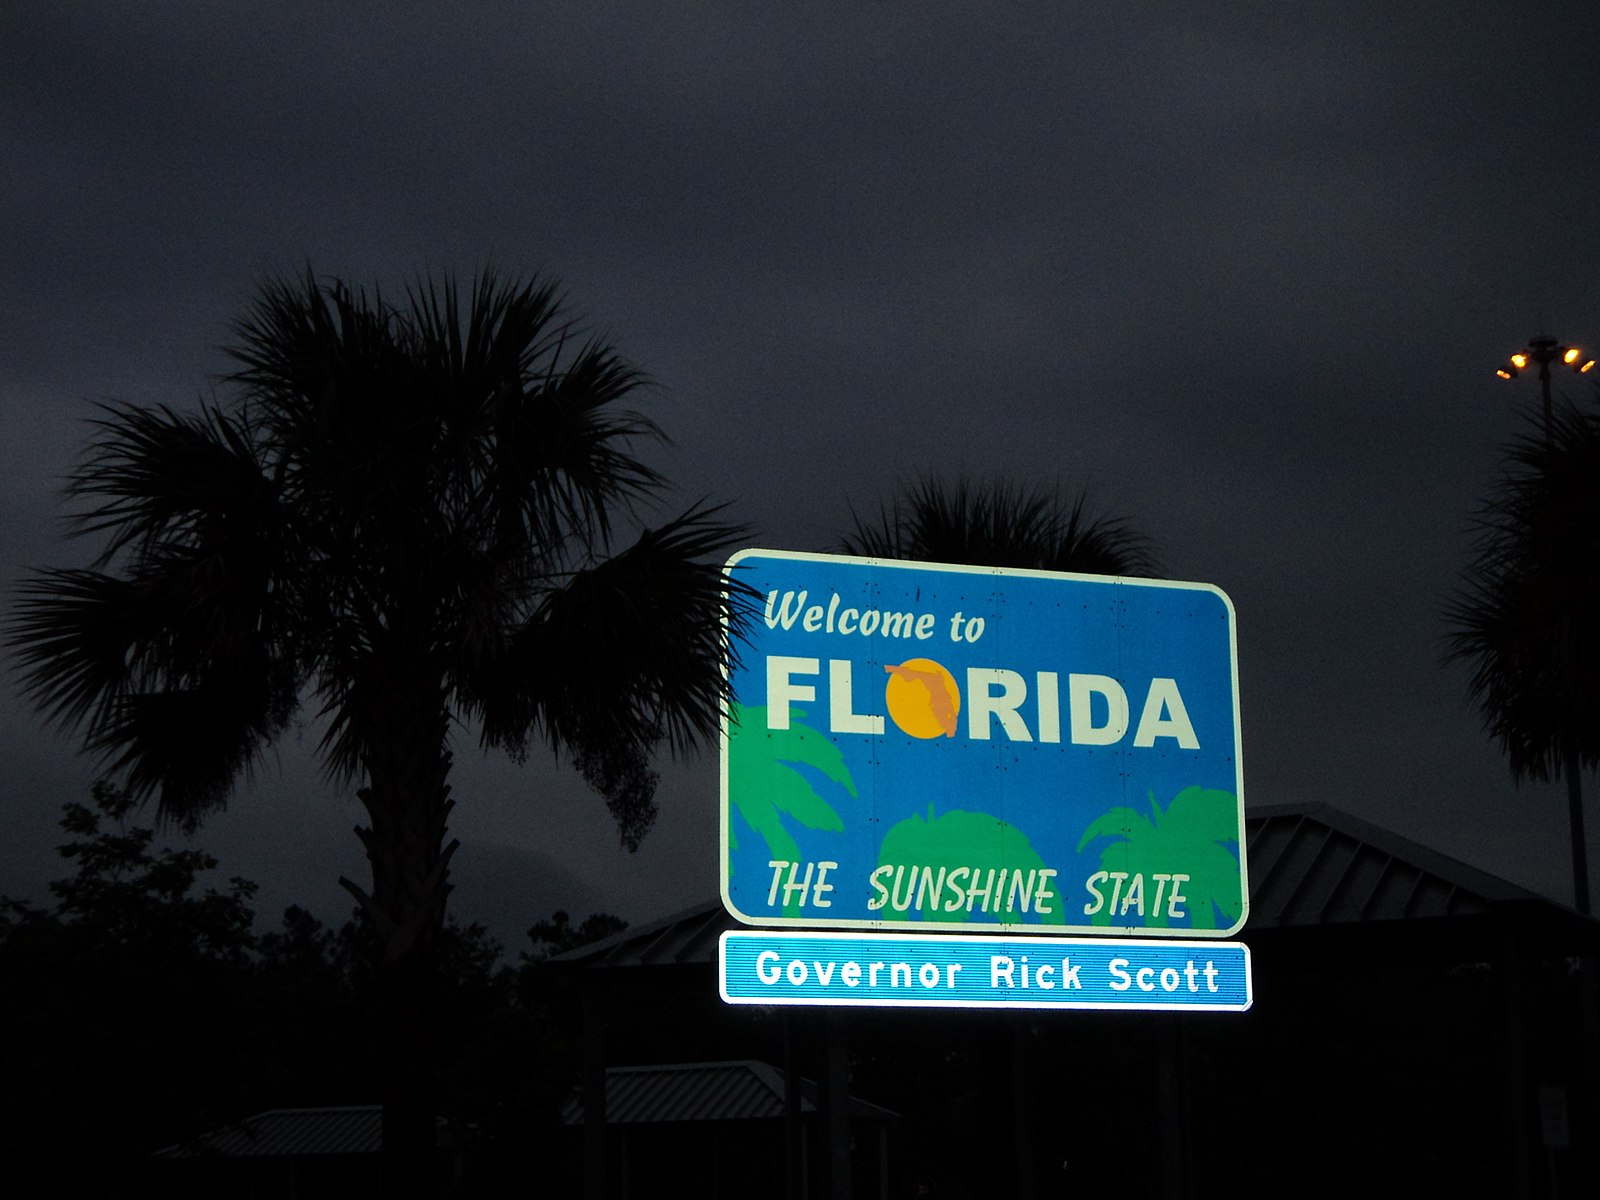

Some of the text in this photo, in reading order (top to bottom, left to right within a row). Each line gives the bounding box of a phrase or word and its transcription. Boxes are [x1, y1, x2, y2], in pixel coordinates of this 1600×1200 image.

[765, 590, 985, 643] Welcome to
[766, 656, 1200, 750] FLORIDA
[767, 860, 1190, 918] THE SUNSHINE STATE
[756, 950, 1219, 993] Governor Rick Scott
